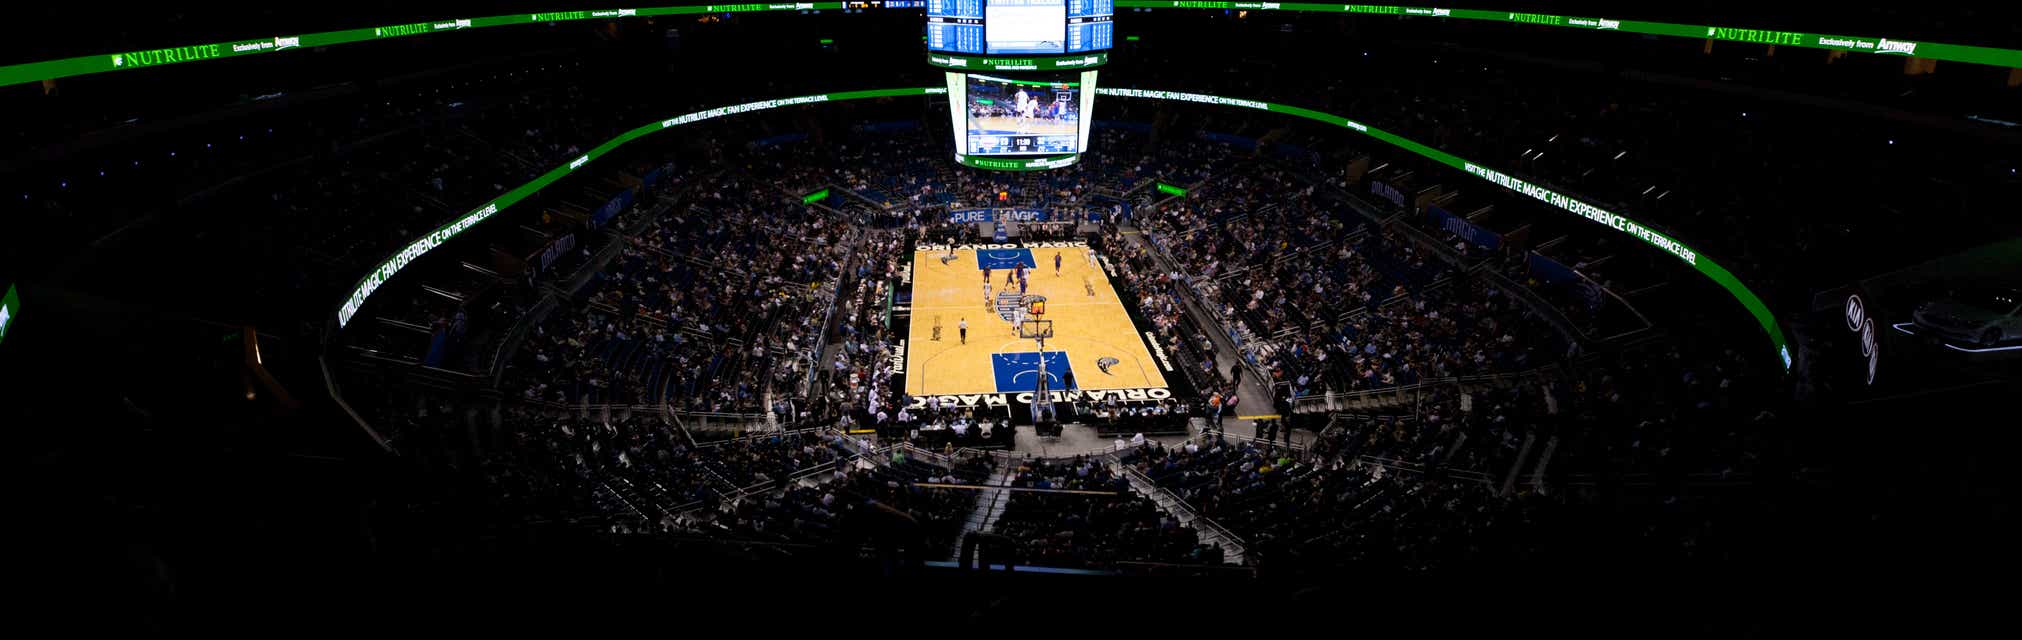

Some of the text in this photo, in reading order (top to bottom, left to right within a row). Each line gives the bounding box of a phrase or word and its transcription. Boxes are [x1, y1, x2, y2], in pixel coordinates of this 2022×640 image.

[538, 11, 585, 22] NUTRILITE
[1350, 5, 1400, 14] NUTRILITE
[1514, 13, 1561, 25] NUTRILITE
[381, 23, 429, 37] NUTRILITE
[1716, 27, 1916, 54] NUTRILITE Exclusively from Amway
[126, 43, 220, 67] NUTRILITE
[233, 43, 261, 52] Exclusively
[1143, 89, 1166, 99] MAGIC
[1166, 91, 1180, 100] FAN
[1180, 92, 1219, 104] EXPERIENCE
[727, 104, 740, 115] FAN
[740, 99, 777, 112] EXPERIENCE
[980, 160, 1019, 168] NUTRILITE
[954, 211, 985, 222] PURE
[1475, 165, 1486, 177] THE
[1486, 169, 1523, 192] NUTRILITE
[1522, 182, 1551, 202] MAGIC
[1550, 191, 1569, 210] FAN
[1569, 199, 1627, 232] EXPERIENCE
[1626, 221, 1638, 235] ON
[1637, 226, 1651, 241] THE
[1650, 231, 1681, 255] TERRACE
[1679, 246, 1696, 266] LEVEL
[916, 240, 1088, 251] ORLANDO MAGIC
[361, 269, 383, 301] MAGIC
[381, 258, 398, 281] FAN
[396, 231, 443, 270] EXPERIENCE
[441, 227, 452, 240] ON
[450, 221, 463, 235] THE
[907, 393, 1007, 409] MAGC
